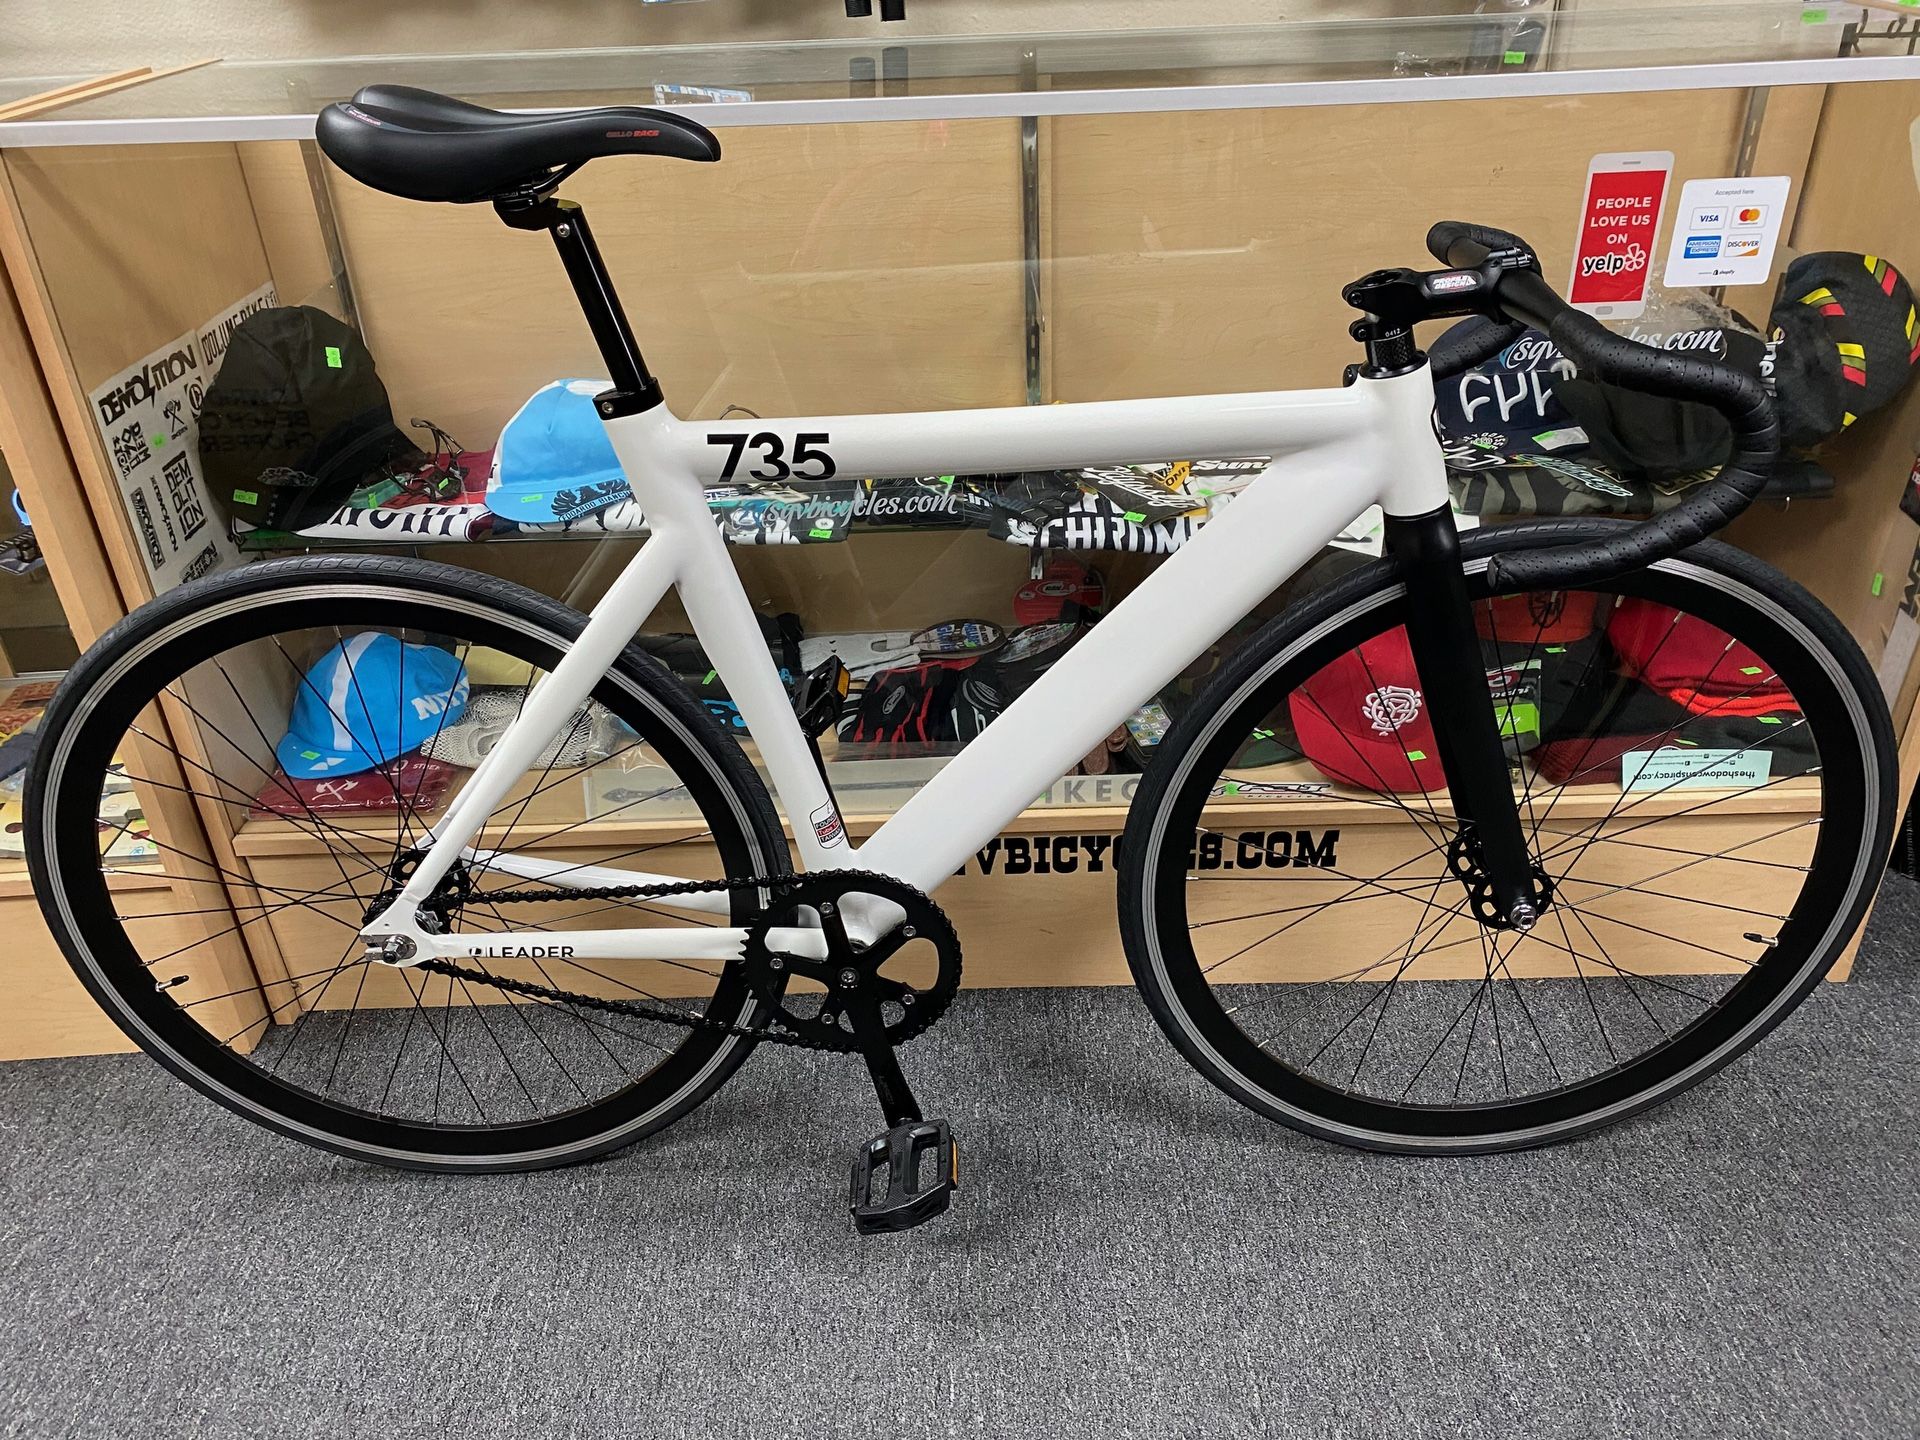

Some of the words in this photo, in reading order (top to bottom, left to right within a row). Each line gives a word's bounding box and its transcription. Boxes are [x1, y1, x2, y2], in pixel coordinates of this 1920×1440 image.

[1595, 196, 1653, 210] PEOPLE
[1589, 214, 1628, 228] LOVE
[1630, 213, 1651, 226] US
[1606, 233, 1628, 244] ON
[1583, 255, 1625, 276] yelp
[1384, 327, 1401, 338] 0412
[98, 344, 198, 427] DEMOLITION
[707, 432, 837, 483] 735
[762, 491, 959, 530] sgvbicycles.com
[488, 945, 575, 958] LEADER
